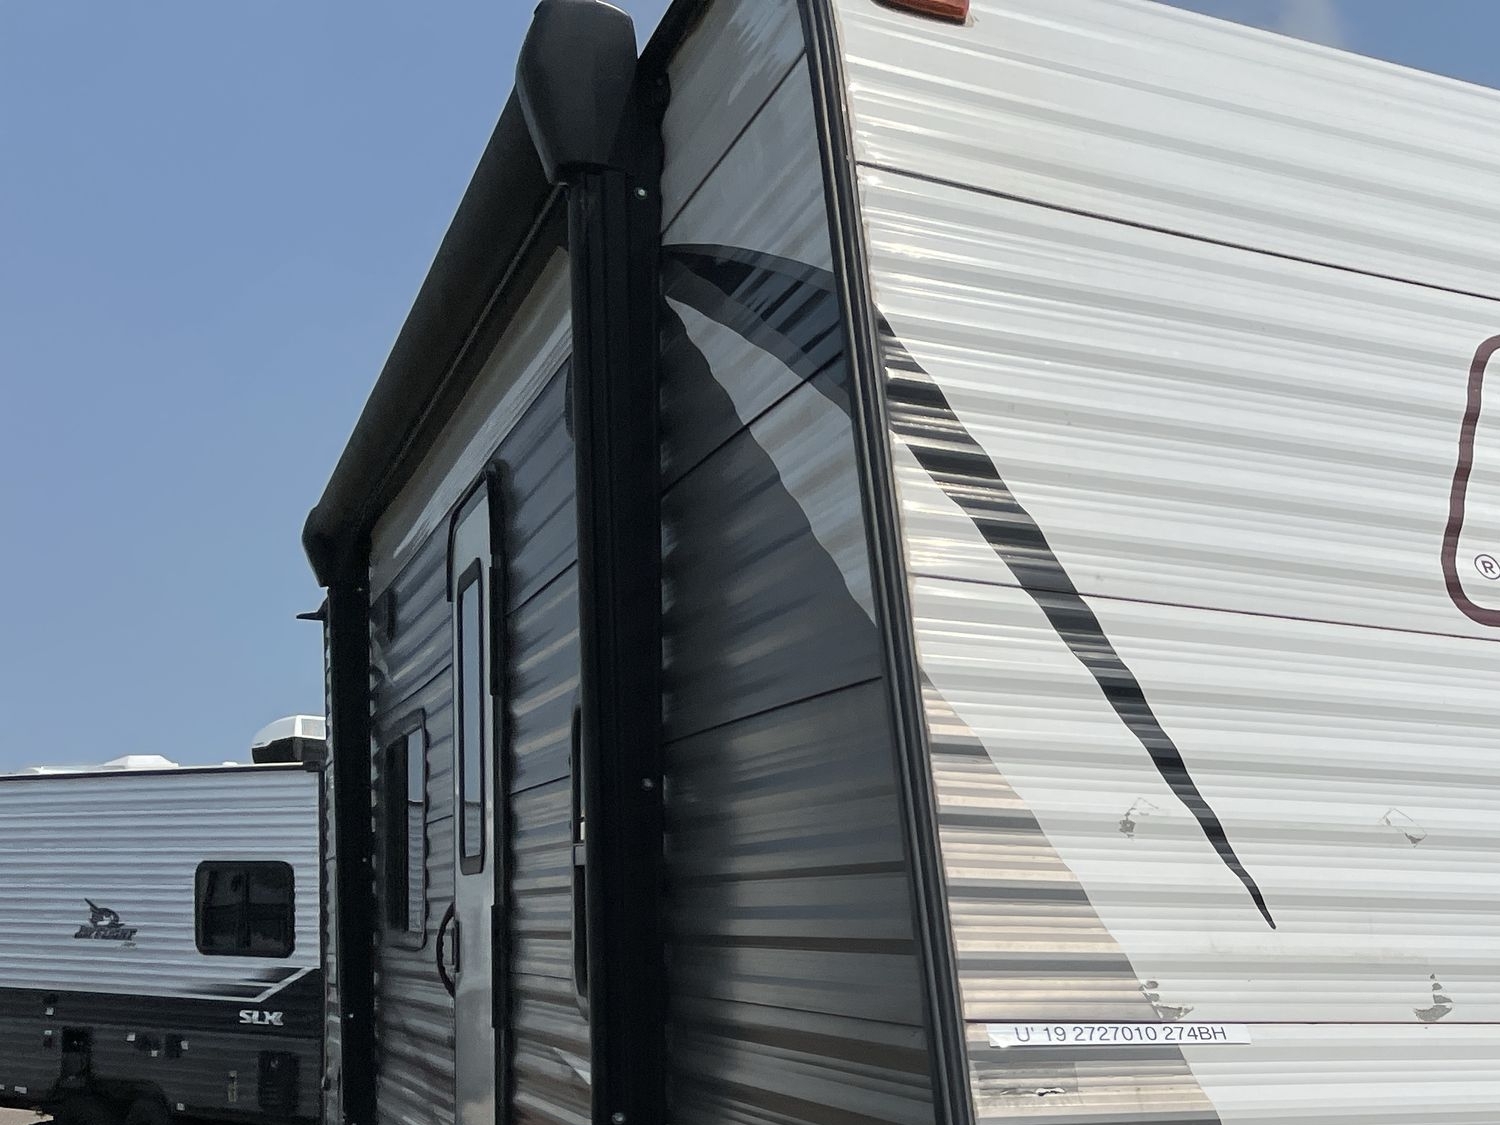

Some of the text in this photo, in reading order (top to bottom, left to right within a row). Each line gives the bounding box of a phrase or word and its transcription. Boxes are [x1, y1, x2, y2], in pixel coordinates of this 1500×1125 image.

[239, 1009, 284, 1026] SLX
[1043, 1026, 1067, 1042] 19
[1072, 1026, 1157, 1041] 2727010
[1162, 1026, 1227, 1041] 274BH
